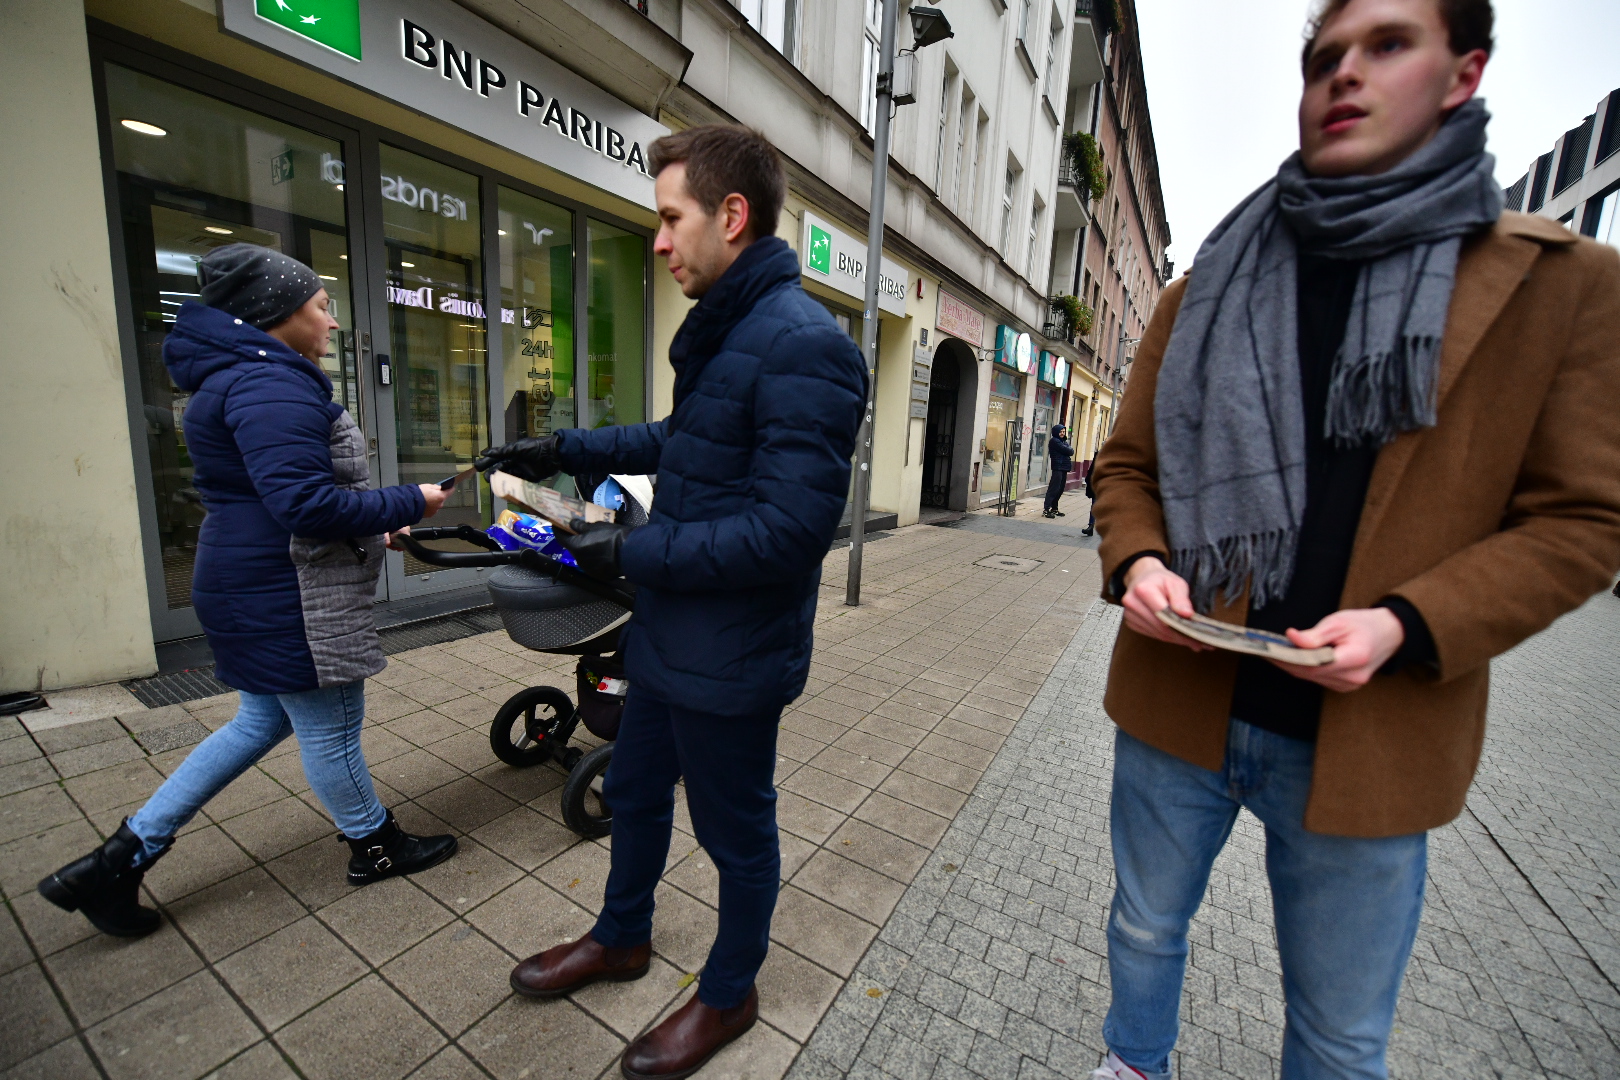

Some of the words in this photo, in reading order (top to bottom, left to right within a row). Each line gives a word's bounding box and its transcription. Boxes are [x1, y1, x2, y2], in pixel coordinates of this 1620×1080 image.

[400, 18, 507, 98] BNP
[517, 80, 655, 180] PARIBA
[836, 251, 862, 278] BNP
[862, 265, 905, 300] RIBAS
[965, 309, 981, 331] Mate
[521, 338, 555, 360] 24h
[588, 352, 618, 362] nkomat
